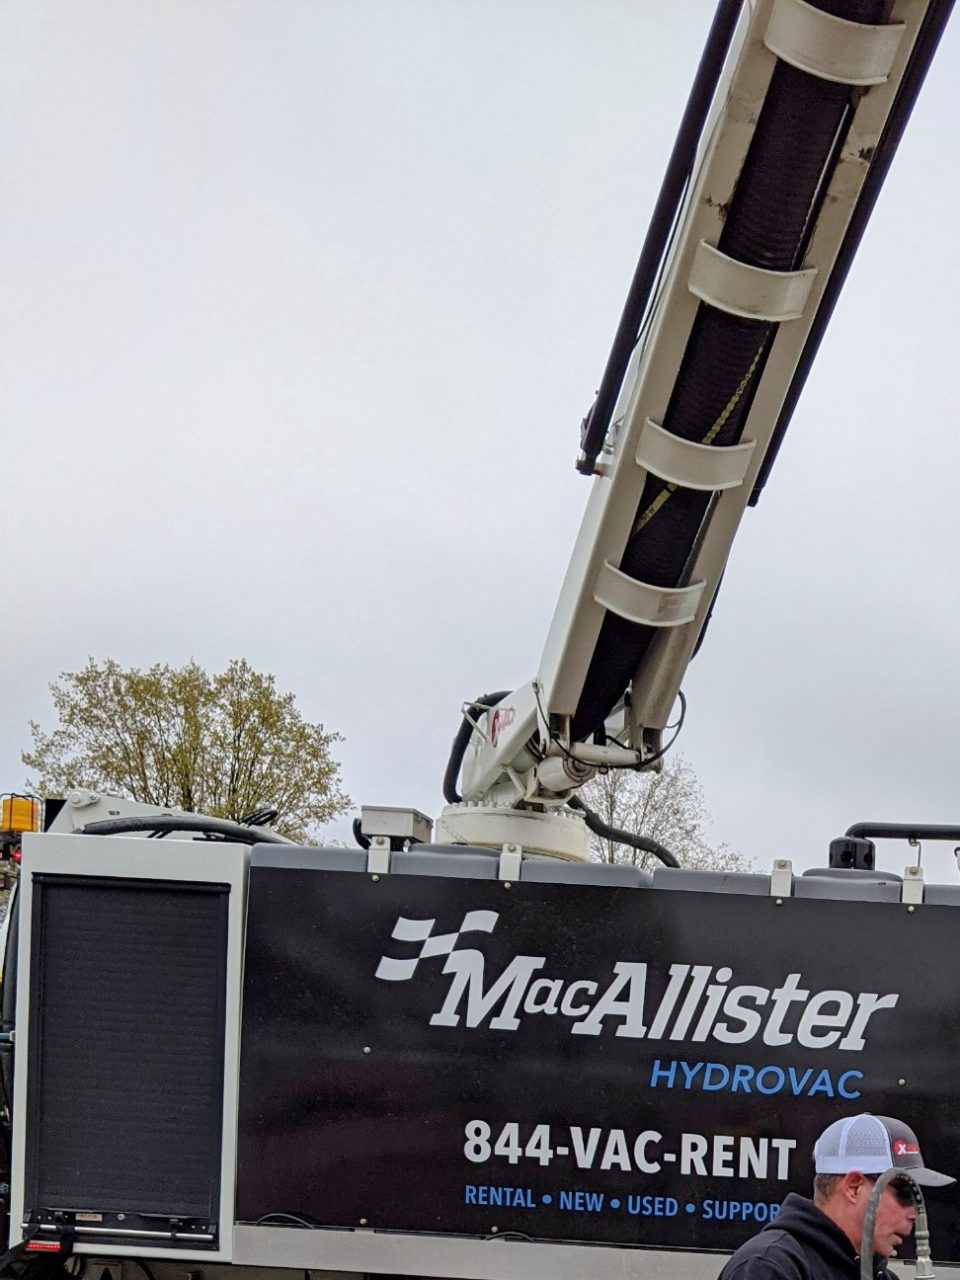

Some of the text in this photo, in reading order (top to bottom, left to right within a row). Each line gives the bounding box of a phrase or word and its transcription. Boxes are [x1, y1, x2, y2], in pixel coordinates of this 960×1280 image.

[430, 949, 898, 1050] MacAllister
[650, 1060, 864, 1099] HYDROVAC
[464, 1120, 797, 1181] 844-VAC-RENT
[465, 1185, 782, 1222] RENTAL NEW USED SUPPOR
